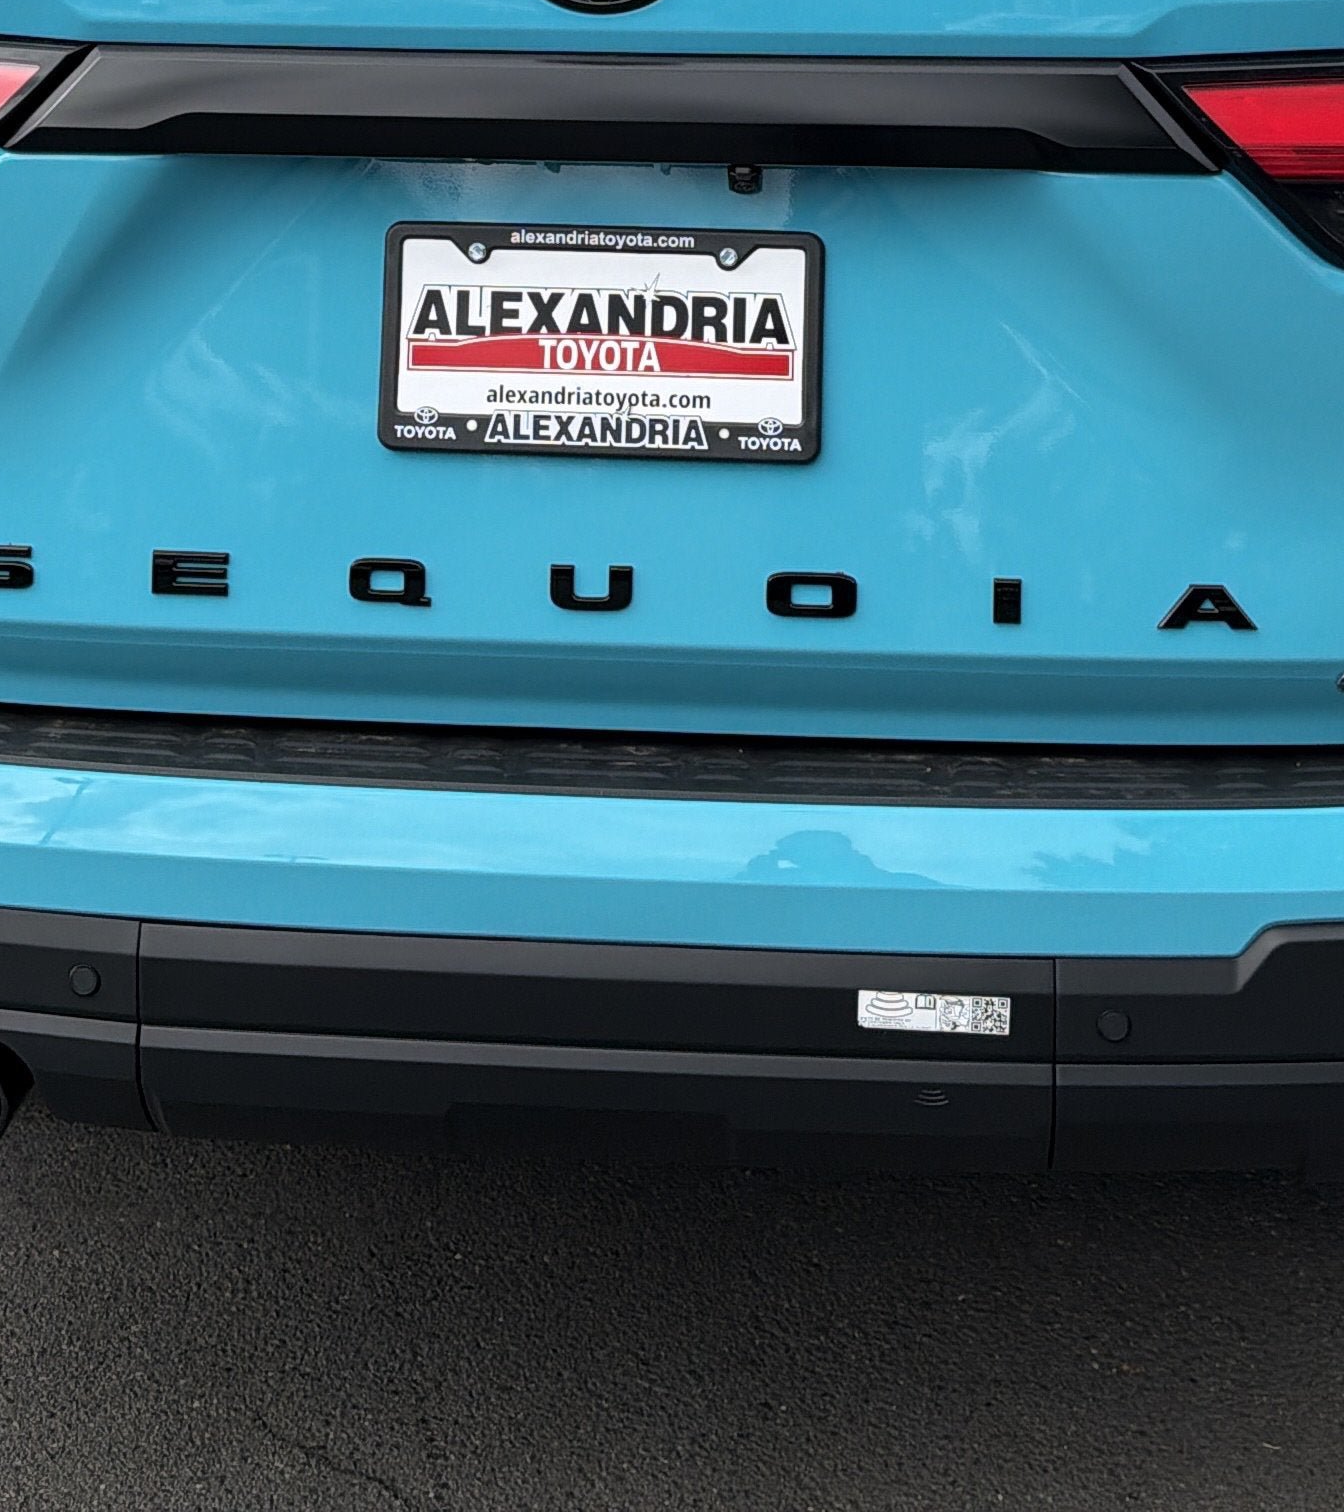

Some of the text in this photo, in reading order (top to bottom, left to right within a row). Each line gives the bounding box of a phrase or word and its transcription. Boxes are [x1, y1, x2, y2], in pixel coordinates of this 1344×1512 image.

[510, 229, 696, 250] alexandriatoyota.com
[412, 288, 792, 346] ALEXANDRIA
[538, 338, 662, 373] TOYOTA
[485, 384, 712, 412] alexandriatoyota.com
[394, 424, 457, 441] TOYOTA
[487, 412, 707, 448] ALEXANDRIA
[738, 435, 802, 453] TOYOTA
